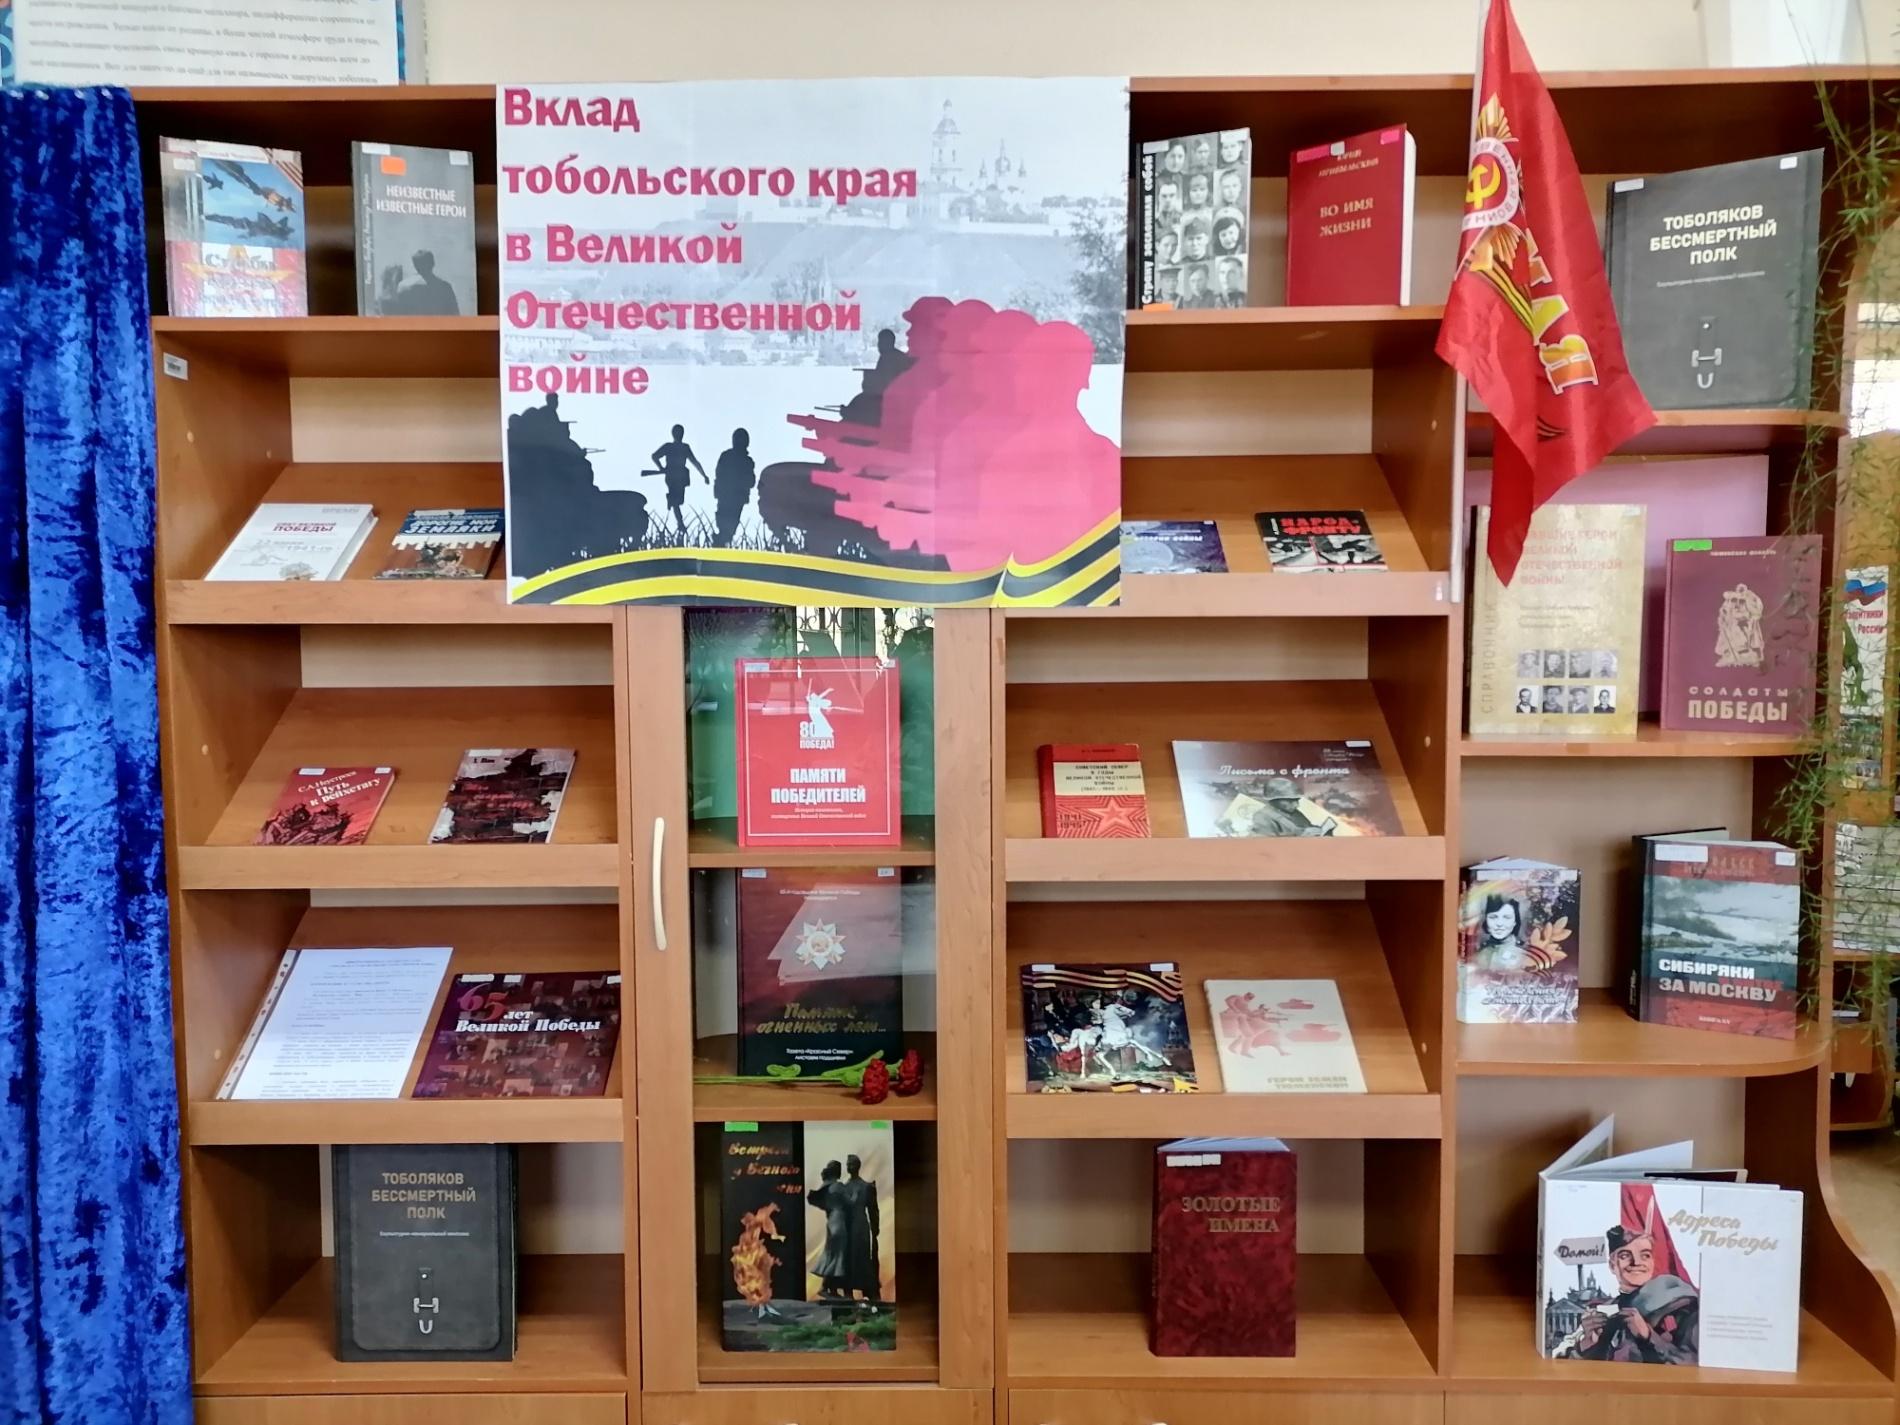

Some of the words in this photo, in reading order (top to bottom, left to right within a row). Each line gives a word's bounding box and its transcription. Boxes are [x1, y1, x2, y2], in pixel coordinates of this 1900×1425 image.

[503, 87, 641, 133] Вклад
[502, 153, 795, 197] тобольского
[808, 165, 917, 204] края
[386, 184, 456, 202] НЕИЗВЕСТНЫЕ
[376, 199, 434, 216] ИЗВЕСТНЫЕ
[435, 204, 467, 219] ГЕРОИ
[1320, 204, 1339, 218] ВО
[1343, 197, 1374, 214] ИМЯ
[1663, 204, 1764, 231] ТОБОЛЯКОВ
[1319, 217, 1373, 238] ЖИЗНИ
[1650, 219, 1778, 252] БЕССМЕРТНЫЙ
[506, 230, 532, 263] в
[546, 222, 743, 264] Великой
[1690, 246, 1738, 265] ПОЛК
[506, 290, 862, 332] Отечественной
[508, 353, 650, 395] войне
[272, 525, 335, 533] ПОБЕДЫ
[404, 525, 497, 535] ЗЕМЛЯКИ
[1688, 699, 1789, 724] ПОБЕДЫ
[800, 739, 835, 750] ПОБЕДА!
[790, 767, 847, 784] ПАМЯТИ
[1218, 764, 1276, 776] Письма
[1291, 764, 1351, 778] фронта
[316, 781, 351, 797] Путь
[771, 784, 867, 806] ПОБЕДИТЕЛЕЙ
[1658, 958, 1756, 980] СИБИРЯКИ
[1658, 977, 1686, 993] ЗА
[1689, 980, 1777, 1003] МОСКВУ
[456, 982, 510, 1022] 65
[502, 1010, 534, 1020] лет
[454, 1019, 530, 1033] Великой
[533, 1019, 601, 1033] Победы
[382, 1172, 465, 1185] ТОБОЛЯКОВ
[371, 1187, 477, 1202] БЕССМЕРТНЫЙ
[1182, 1196, 1282, 1213] ЗОЛОТЫЕ
[407, 1206, 446, 1219] ПОЛК
[1667, 1208, 1742, 1236] Адреса
[1209, 1217, 1281, 1233] ИМЕНА
[1557, 1243, 1606, 1259] Домой!
[1697, 1229, 1779, 1257] Победы
